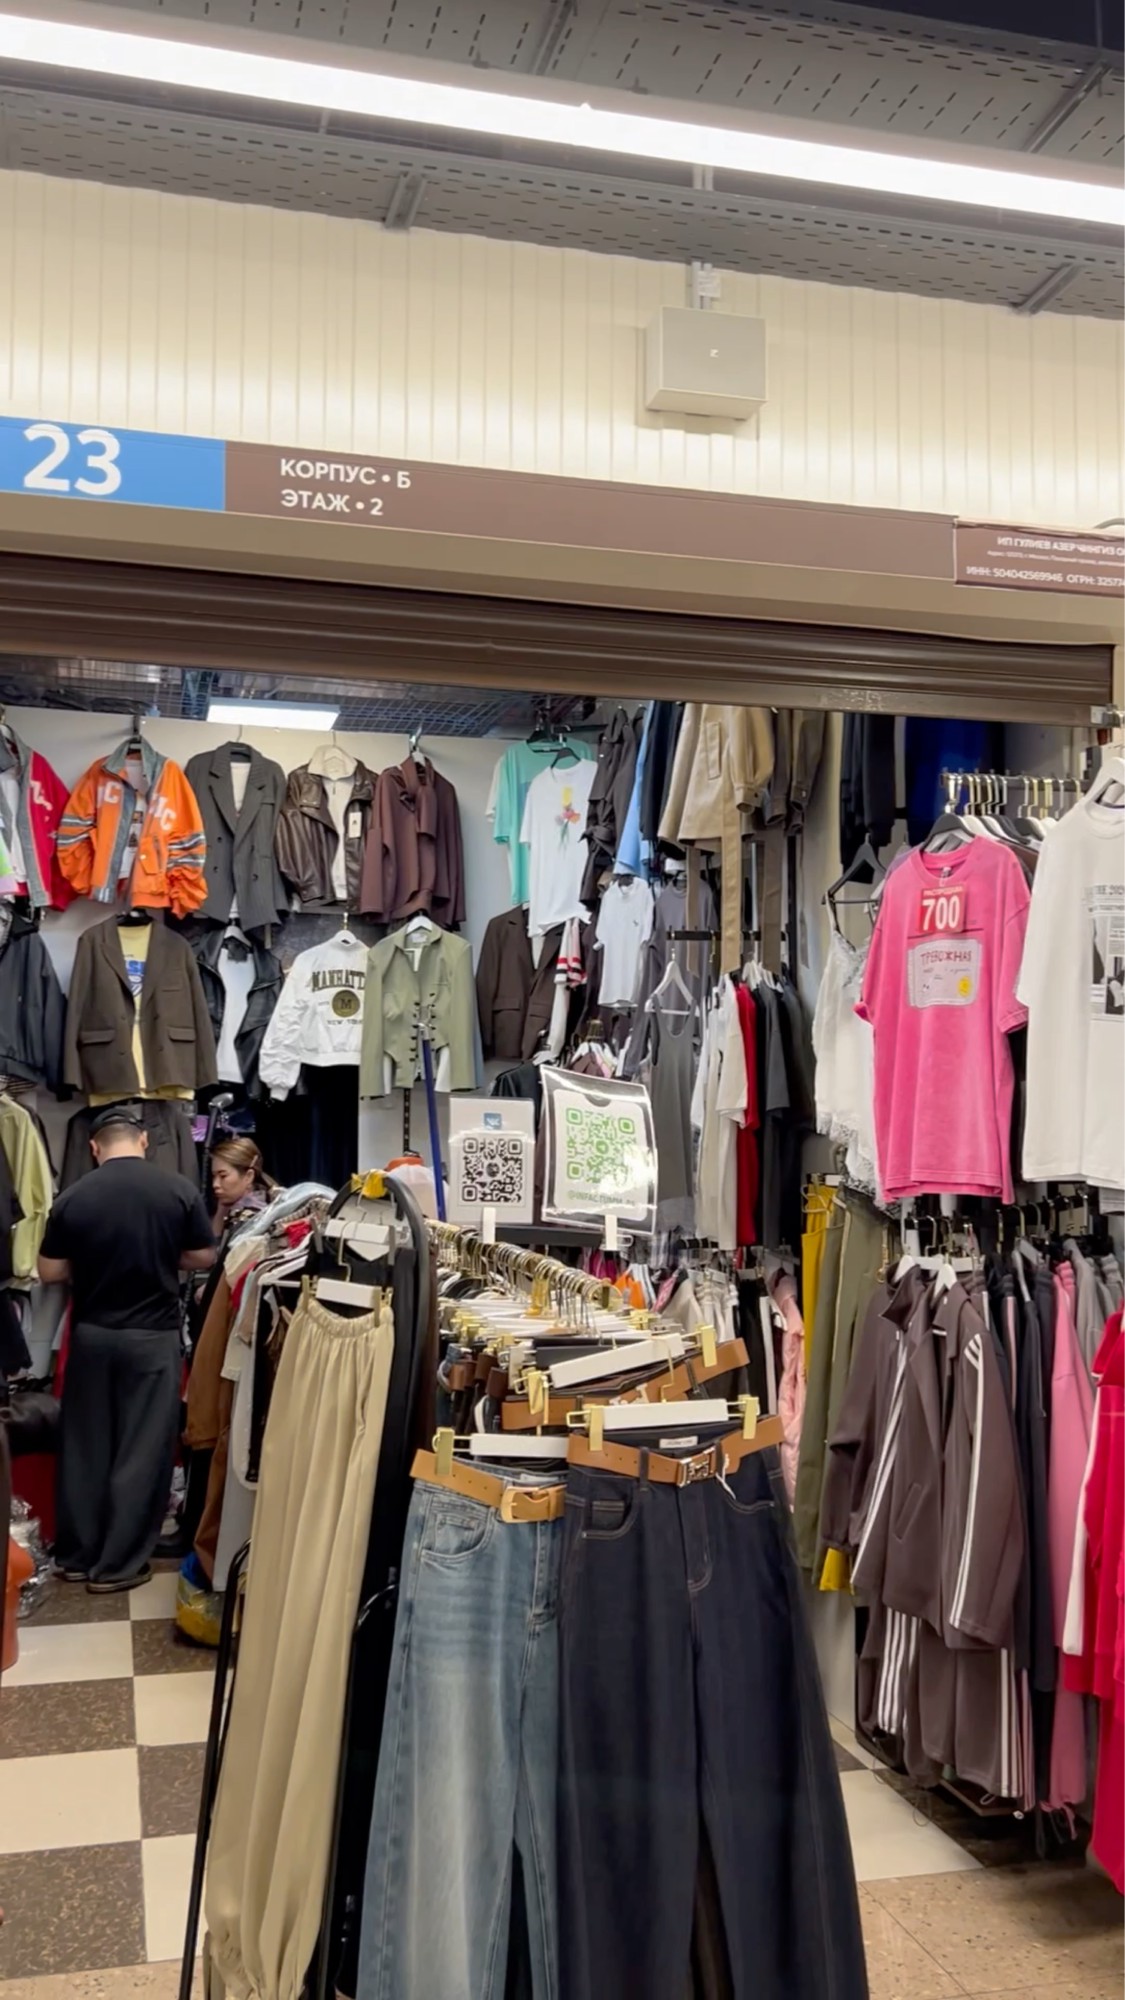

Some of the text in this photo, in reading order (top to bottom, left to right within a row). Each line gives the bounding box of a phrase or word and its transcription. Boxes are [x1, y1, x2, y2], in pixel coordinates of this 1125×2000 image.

[22, 423, 123, 496] 23
[280, 458, 411, 489] КОРПУС Б
[280, 488, 384, 516] ЭТАЖ 2
[997, 536, 1013, 546] ИП
[966, 565, 992, 577] ИНН:
[922, 895, 961, 931] 700
[312, 969, 366, 992] MANHATT
